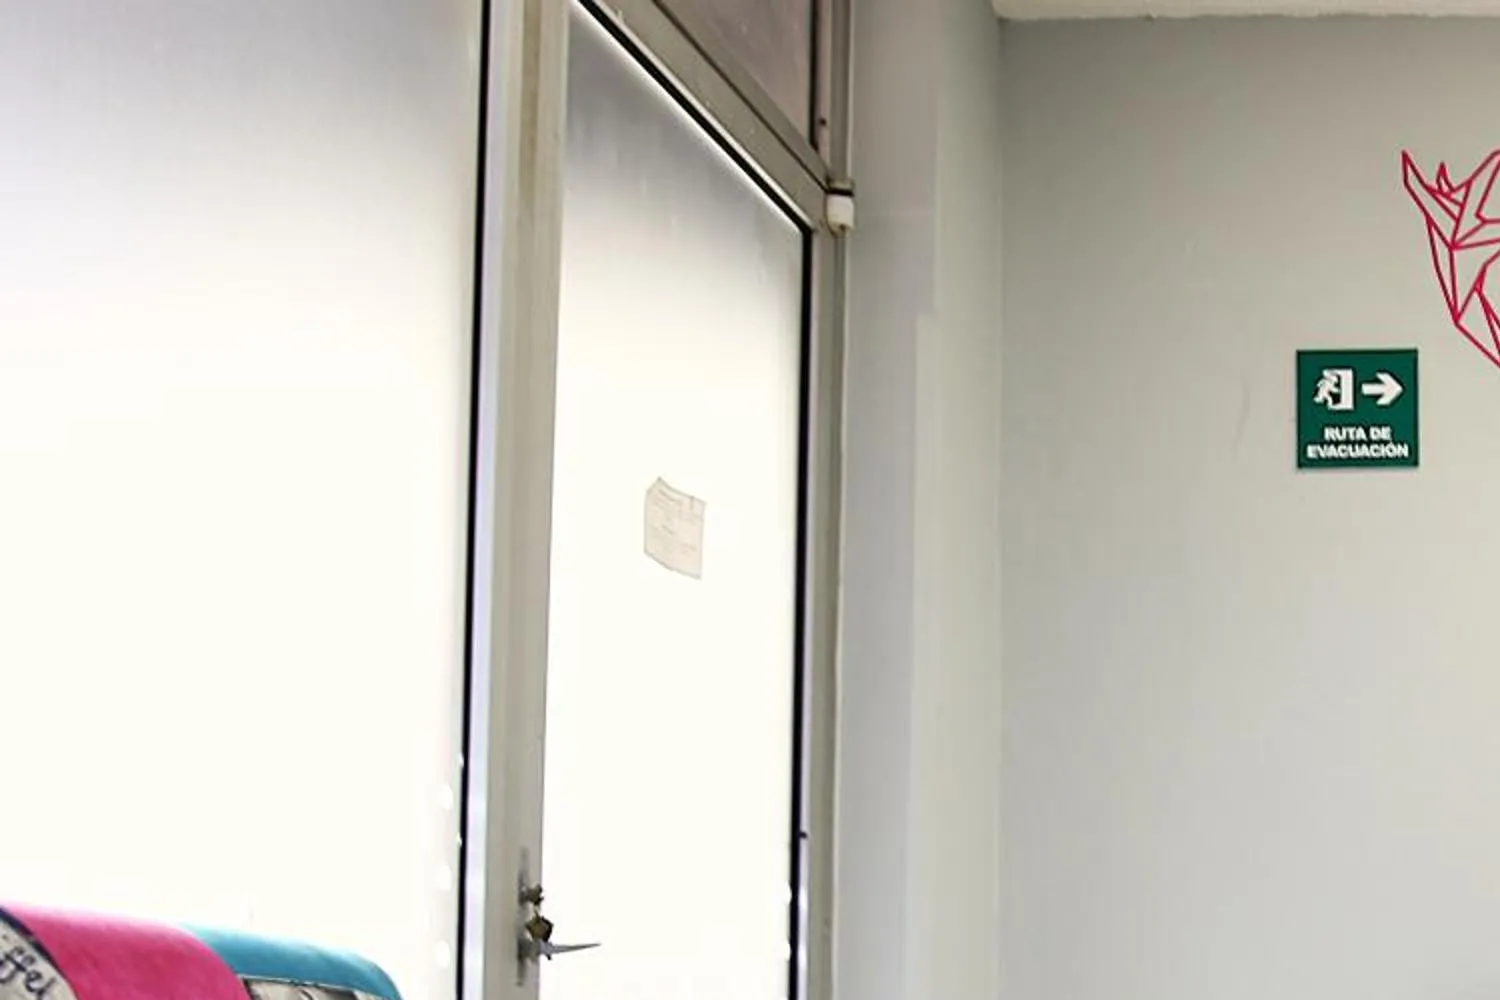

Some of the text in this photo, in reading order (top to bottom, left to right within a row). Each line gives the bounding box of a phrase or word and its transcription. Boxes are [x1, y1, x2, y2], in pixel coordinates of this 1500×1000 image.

[1324, 426, 1392, 441] RUTA DE
[1307, 442, 1408, 458] EVACUACIÓN
